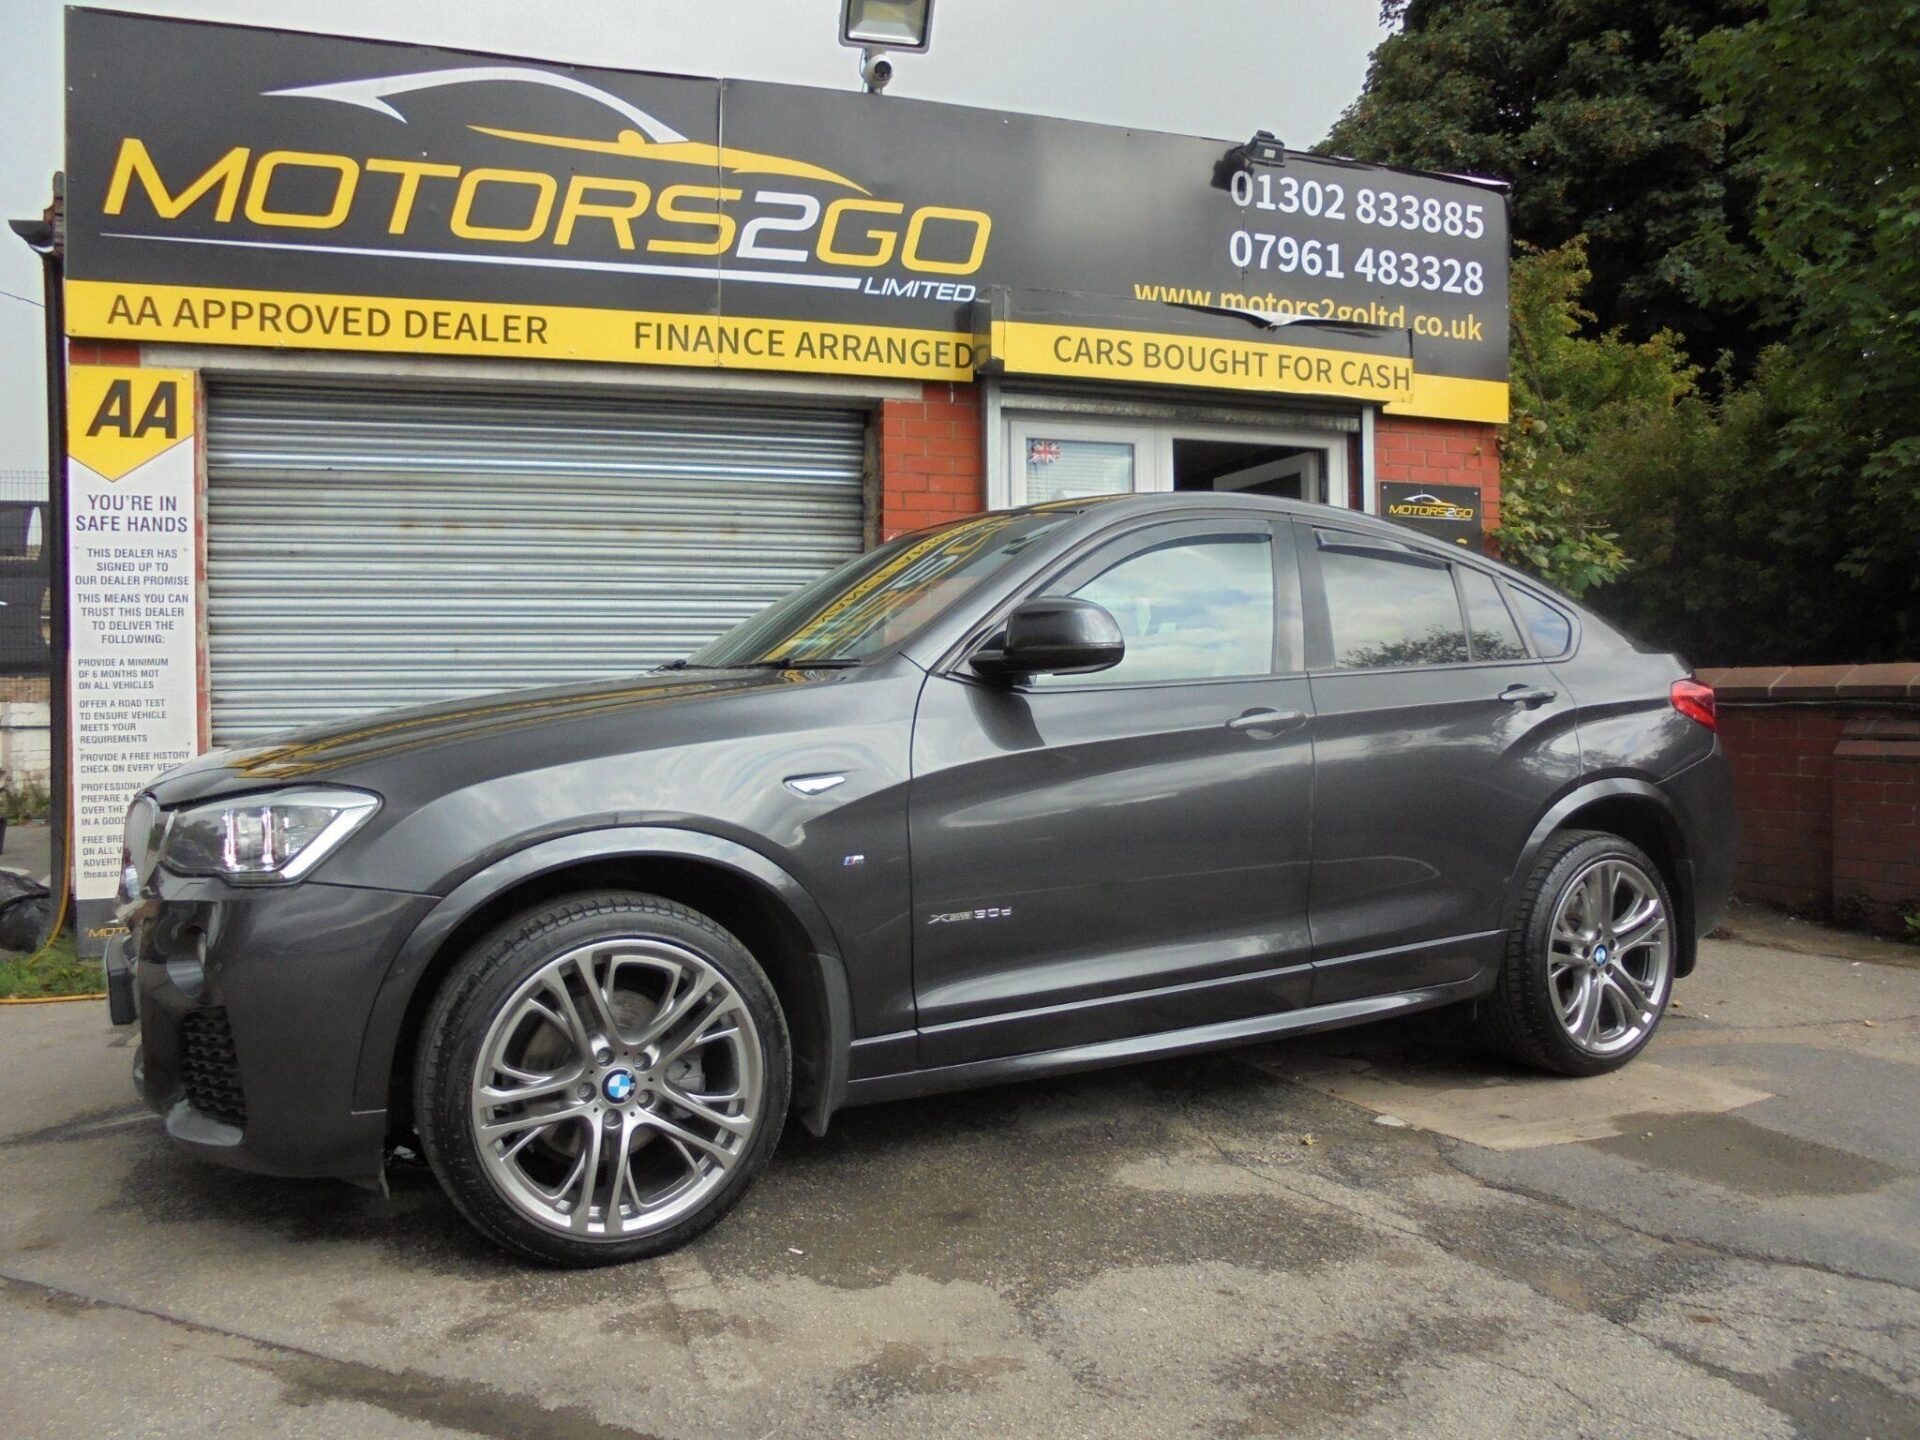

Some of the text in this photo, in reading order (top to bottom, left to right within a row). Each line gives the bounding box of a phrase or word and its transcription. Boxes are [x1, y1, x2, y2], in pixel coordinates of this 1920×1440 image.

[103, 137, 992, 275] MOTORS2GO
[1230, 169, 1485, 240] 01302 833885
[1229, 229, 1484, 297] 07961 483328
[863, 276, 977, 303] LIMITED
[1133, 282, 1483, 342] wwwmotors2goltdco.uk
[107, 294, 549, 345] AA APPROVED DEALER
[634, 321, 975, 370] FINANCE ARRANGED
[1053, 335, 1411, 392] CARS BOUGHT FOR CASH
[85, 379, 177, 440] AA
[87, 494, 177, 512] YOU'RE IN
[1388, 504, 1474, 518] MOTORS2GO
[76, 515, 188, 533] SAFE HANDS
[87, 548, 178, 559] THIS DEALER HAS
[96, 562, 169, 572] SIGNED UP TO
[75, 576, 190, 586] OUR DEALER PROMISE
[77, 594, 189, 604] THIS MEANS YOU CAN
[81, 607, 185, 617] TRUST THIS DEALER
[92, 621, 174, 631] TO DELIVER THE
[101, 634, 165, 644] FOLLOWING:
[78, 658, 116, 667] PROVIDE
[127, 658, 169, 666] MINIMUM
[79, 670, 159, 678] OF 6 MONTHS MOT
[79, 681, 154, 690] ON ALL VEHICLES
[80, 699, 165, 708] OFFER A ROAD TEST
[80, 711, 167, 720] TO ENSURE VEHICLE
[80, 723, 136, 732] MEETS YOUR
[80, 735, 148, 744] REQUIREMENTS
[80, 751, 190, 762] PROVIDE A FREE HISTORY
[80, 765, 110, 774] CHECK
[113, 765, 124, 773] ON
[127, 764, 154, 772] EVERY
[81, 783, 145, 792] PROFESSIONA
[81, 794, 121, 803] PREPARE
[82, 805, 124, 815] OVER THE
[82, 818, 91, 826] IN
[93, 818, 100, 826] A
[82, 835, 104, 844] FREE
[83, 847, 95, 856] ON
[97, 846, 115, 855] ALL
[83, 858, 122, 867] ADVERTI
[83, 870, 120, 879] theaa.co
